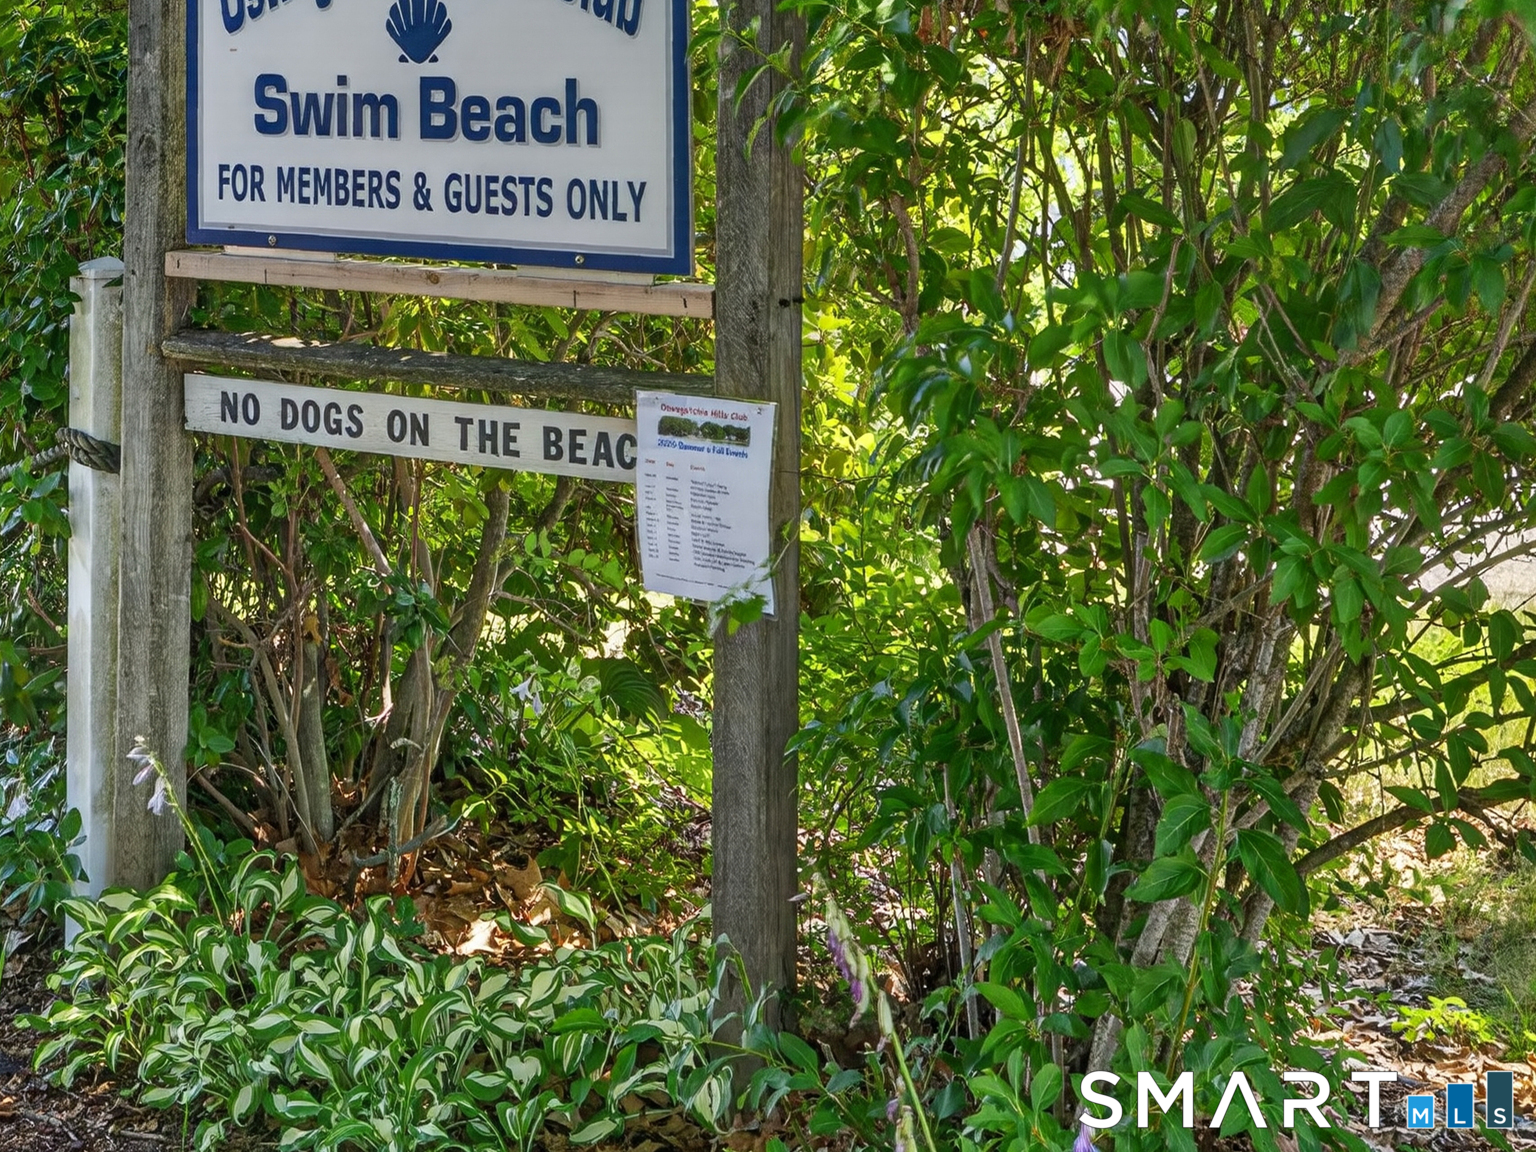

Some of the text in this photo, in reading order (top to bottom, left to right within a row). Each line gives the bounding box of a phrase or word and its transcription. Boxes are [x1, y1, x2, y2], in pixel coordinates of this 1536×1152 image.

[253, 73, 601, 147] Swim Beach
[218, 163, 647, 224] FOR MEMBERS & GUESTS ONLY
[220, 390, 638, 471] NO DOGS ON THE BEAC
[710, 409, 729, 420] Hills
[730, 412, 748, 421] Club
